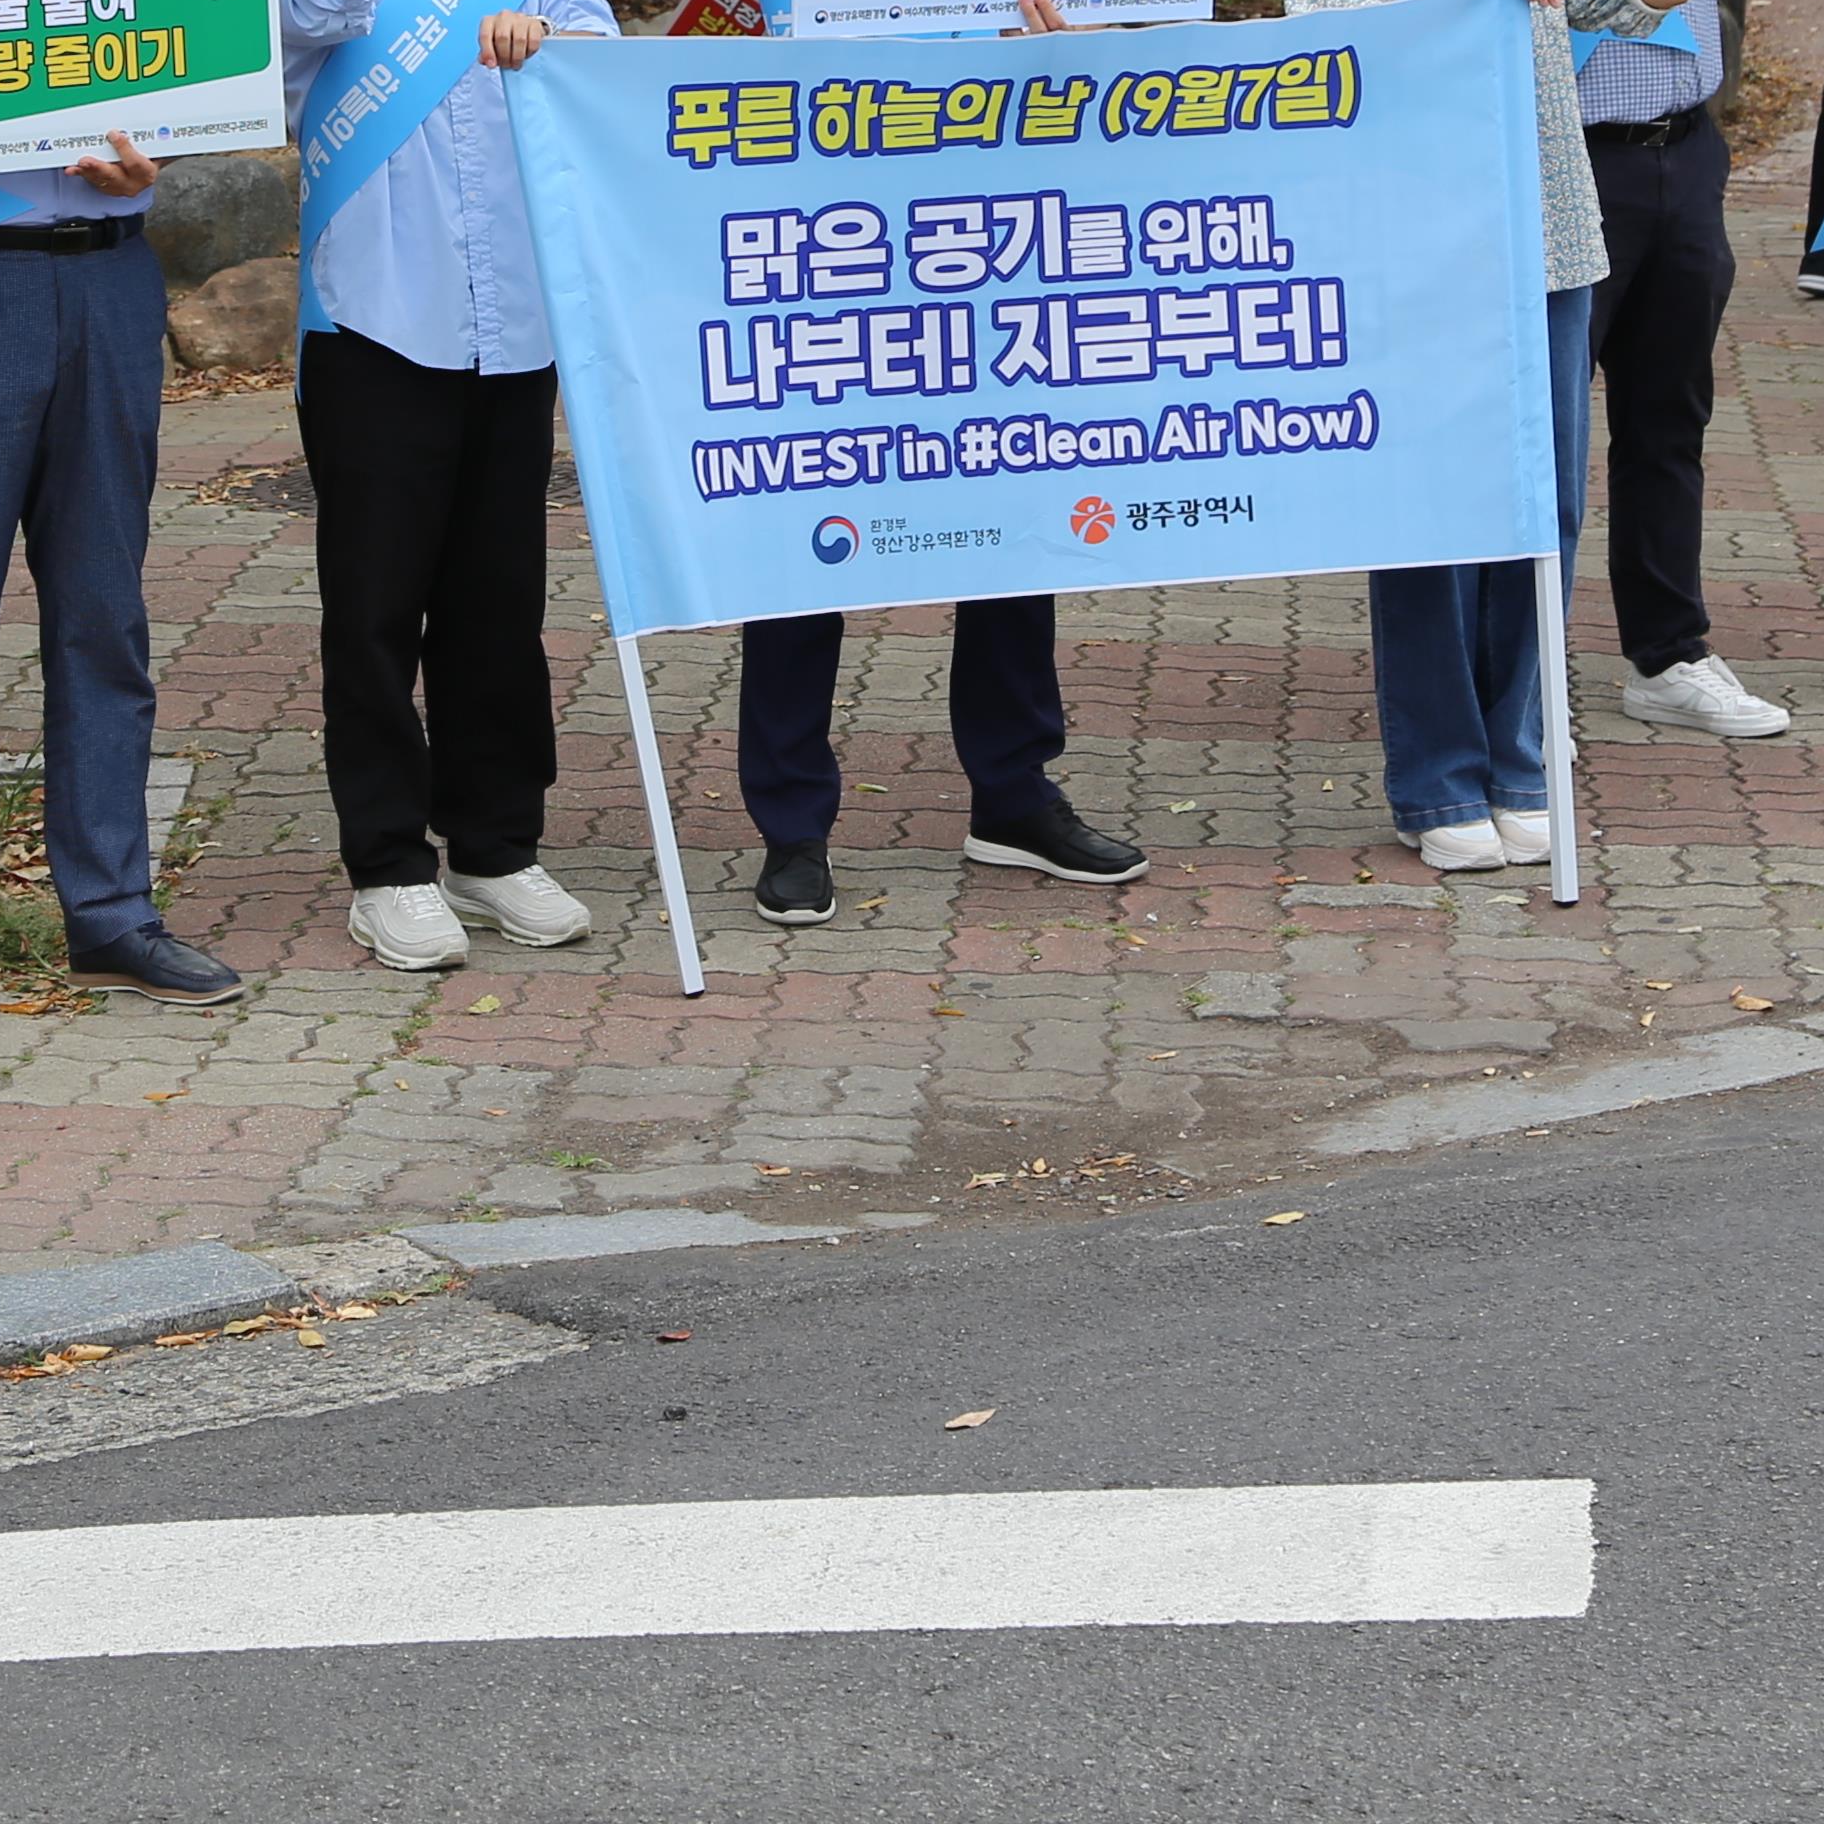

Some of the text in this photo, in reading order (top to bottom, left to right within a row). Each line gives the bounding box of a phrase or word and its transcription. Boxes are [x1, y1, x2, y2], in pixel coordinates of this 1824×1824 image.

[991, 1, 1019, 12] 여수광양
[43, 26, 187, 89] 줄이기
[387, 13, 449, 75] 푸른
[319, 62, 401, 152] 하늘의
[667, 46, 1362, 167] 푸른 하늘의 날 (9월7일)
[721, 190, 1294, 306] 맑은 공기를 위해,
[698, 279, 1347, 412] 나부터! 지금부터!
[692, 390, 1377, 503] (INVEST in #Clean Air Now)
[869, 516, 909, 535] 환경부
[871, 525, 1002, 555] 영산강유역환경청
[1125, 491, 1256, 531] 광주광역시
